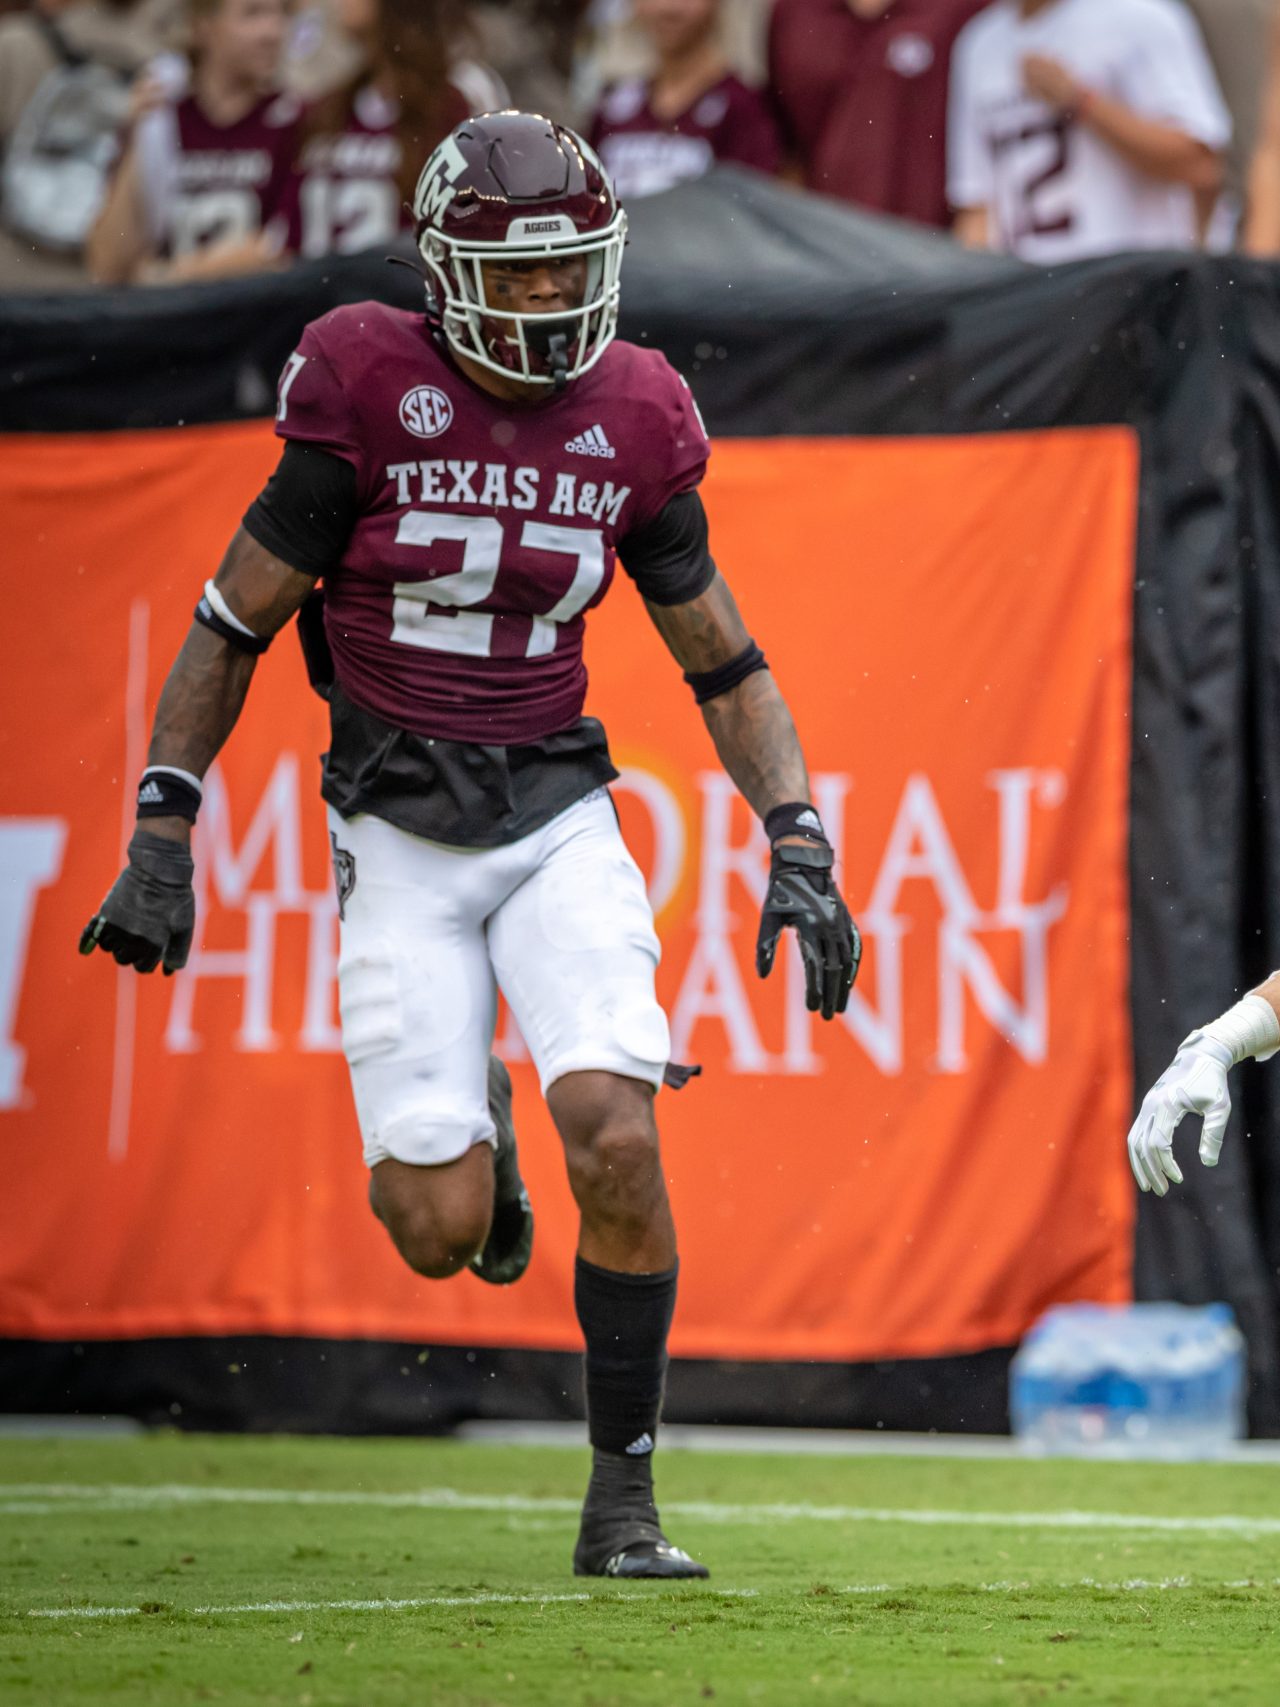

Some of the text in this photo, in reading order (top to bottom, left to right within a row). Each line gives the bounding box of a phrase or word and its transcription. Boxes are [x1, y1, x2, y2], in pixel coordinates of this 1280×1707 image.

[523, 220, 562, 235] AGGIES
[403, 390, 449, 434] SEC
[564, 440, 616, 459] adidas
[386, 459, 632, 527] TEXAS A&M
[390, 509, 606, 658] 27
